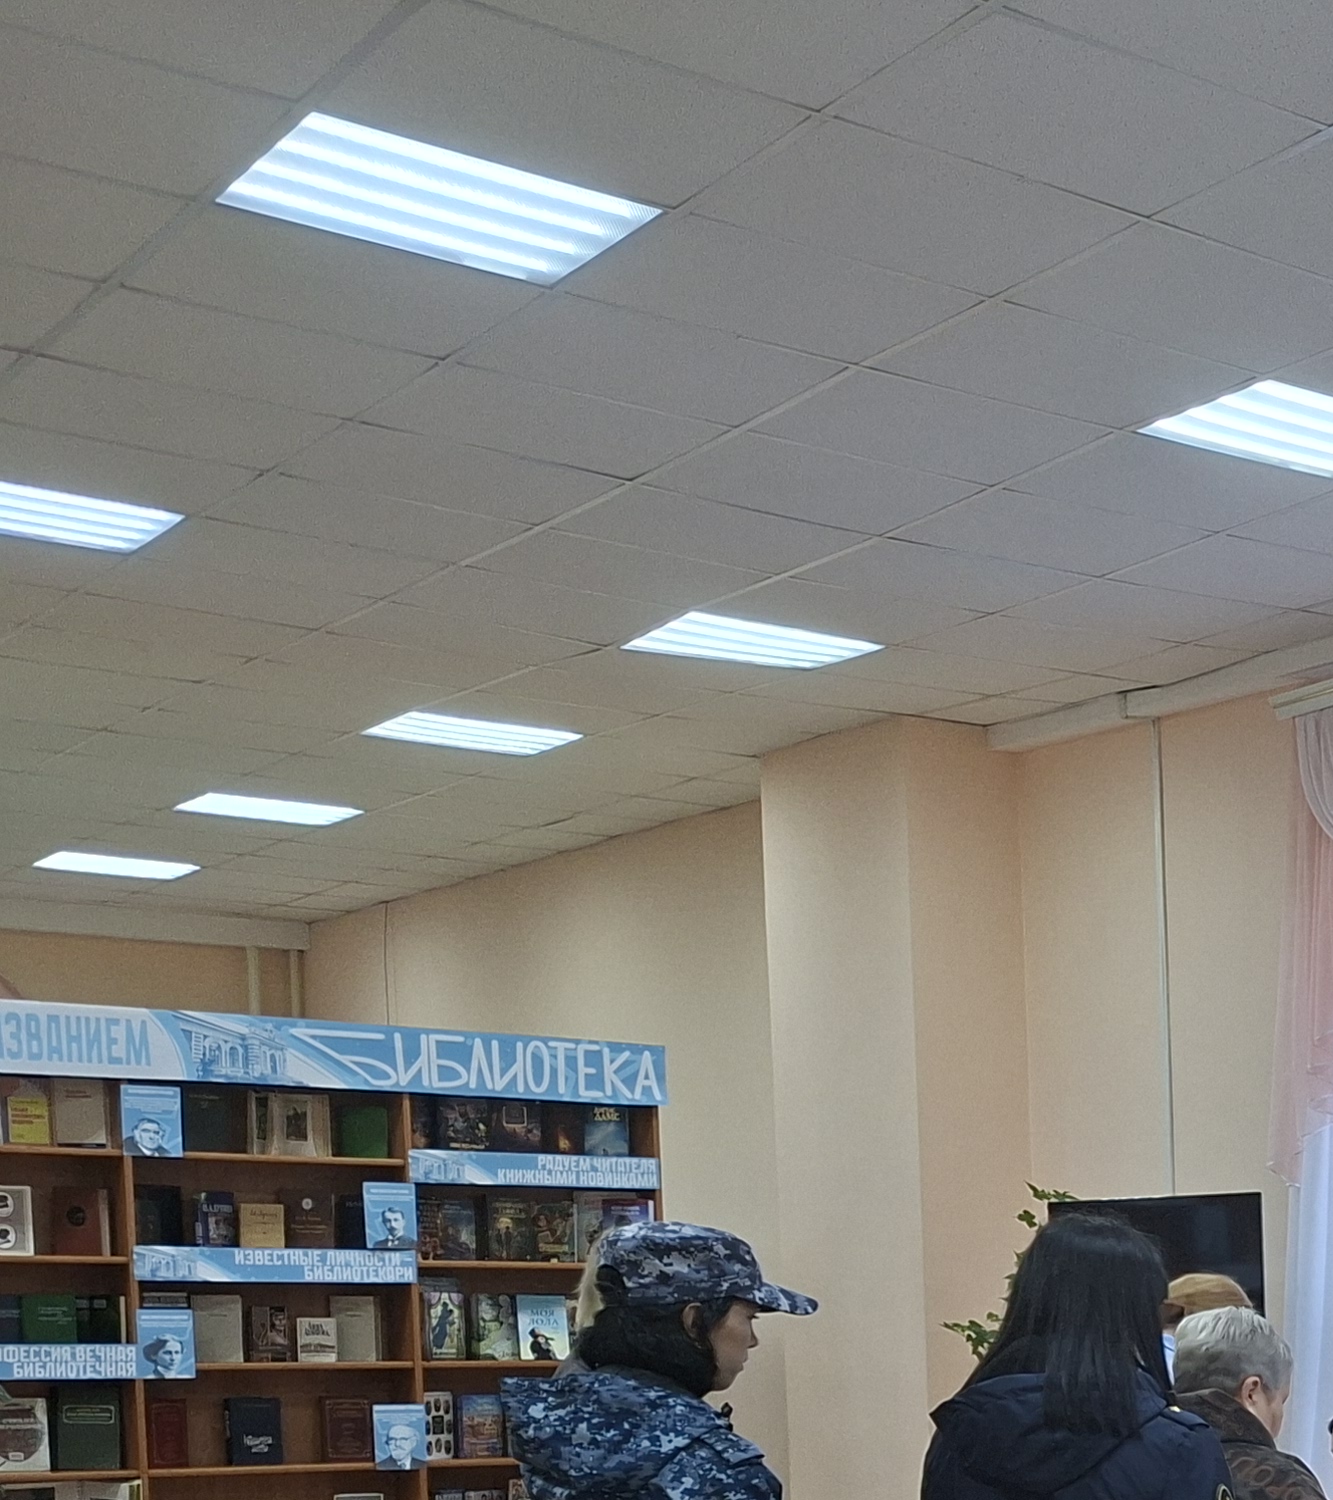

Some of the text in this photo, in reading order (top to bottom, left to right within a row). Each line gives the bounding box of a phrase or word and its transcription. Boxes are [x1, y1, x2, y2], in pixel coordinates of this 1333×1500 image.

[0, 1011, 152, 1067] ЗВАНИЕМ
[290, 1027, 662, 1101] БИБЛИОТЕКА
[538, 1155, 657, 1173] РАДУЕМ ЧИТАТЕЛЯ
[497, 1168, 658, 1187] КНИЖНЫМИ НОВИНКАМИ
[234, 1249, 322, 1266] ИЗВЕСТНЫЕ
[325, 1250, 401, 1267] ЛИЧНОСТИ
[304, 1265, 413, 1281] БИБЛИОТЕКАРИ
[0, 1345, 137, 1363] ФЕССИЯ ВЕЧНАЯ
[13, 1362, 137, 1379] БИБЛИОТЕЧНАЯ
